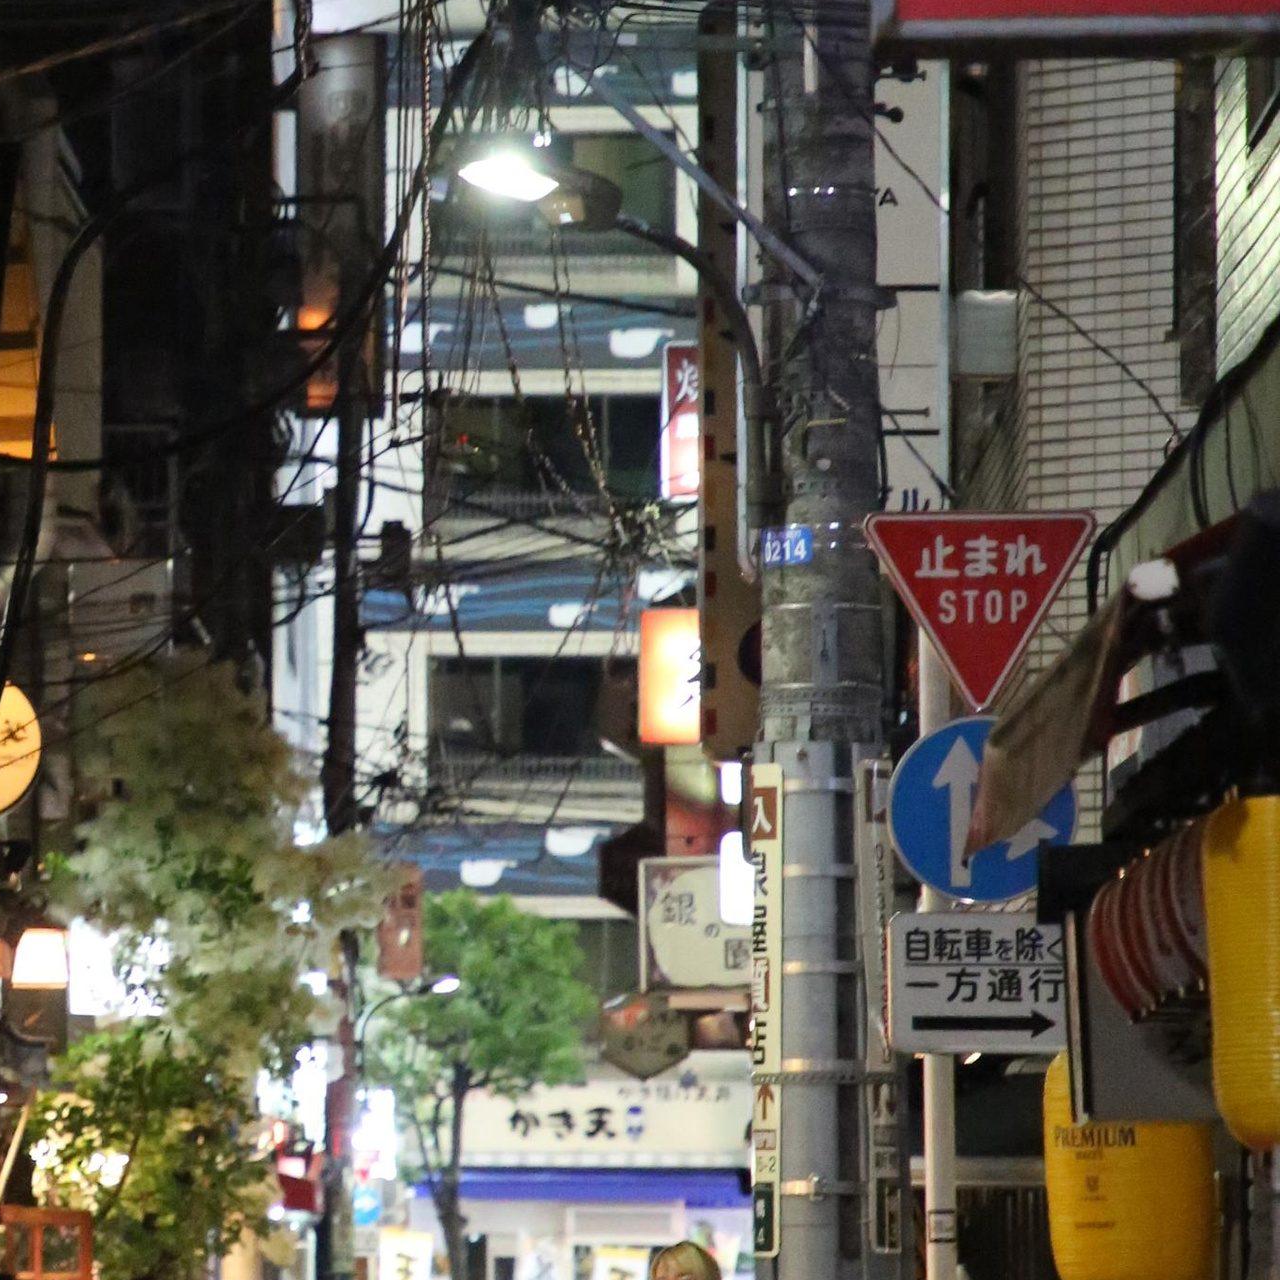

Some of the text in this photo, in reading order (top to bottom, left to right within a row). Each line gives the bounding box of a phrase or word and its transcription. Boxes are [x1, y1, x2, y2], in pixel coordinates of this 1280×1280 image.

[915, 533, 1048, 579] 止まれ
[938, 589, 1029, 623] STOP
[905, 927, 1064, 962] 自転車を除く
[905, 967, 1065, 1003] 一方通行
[1054, 1124, 1136, 1148] PREMIUM
